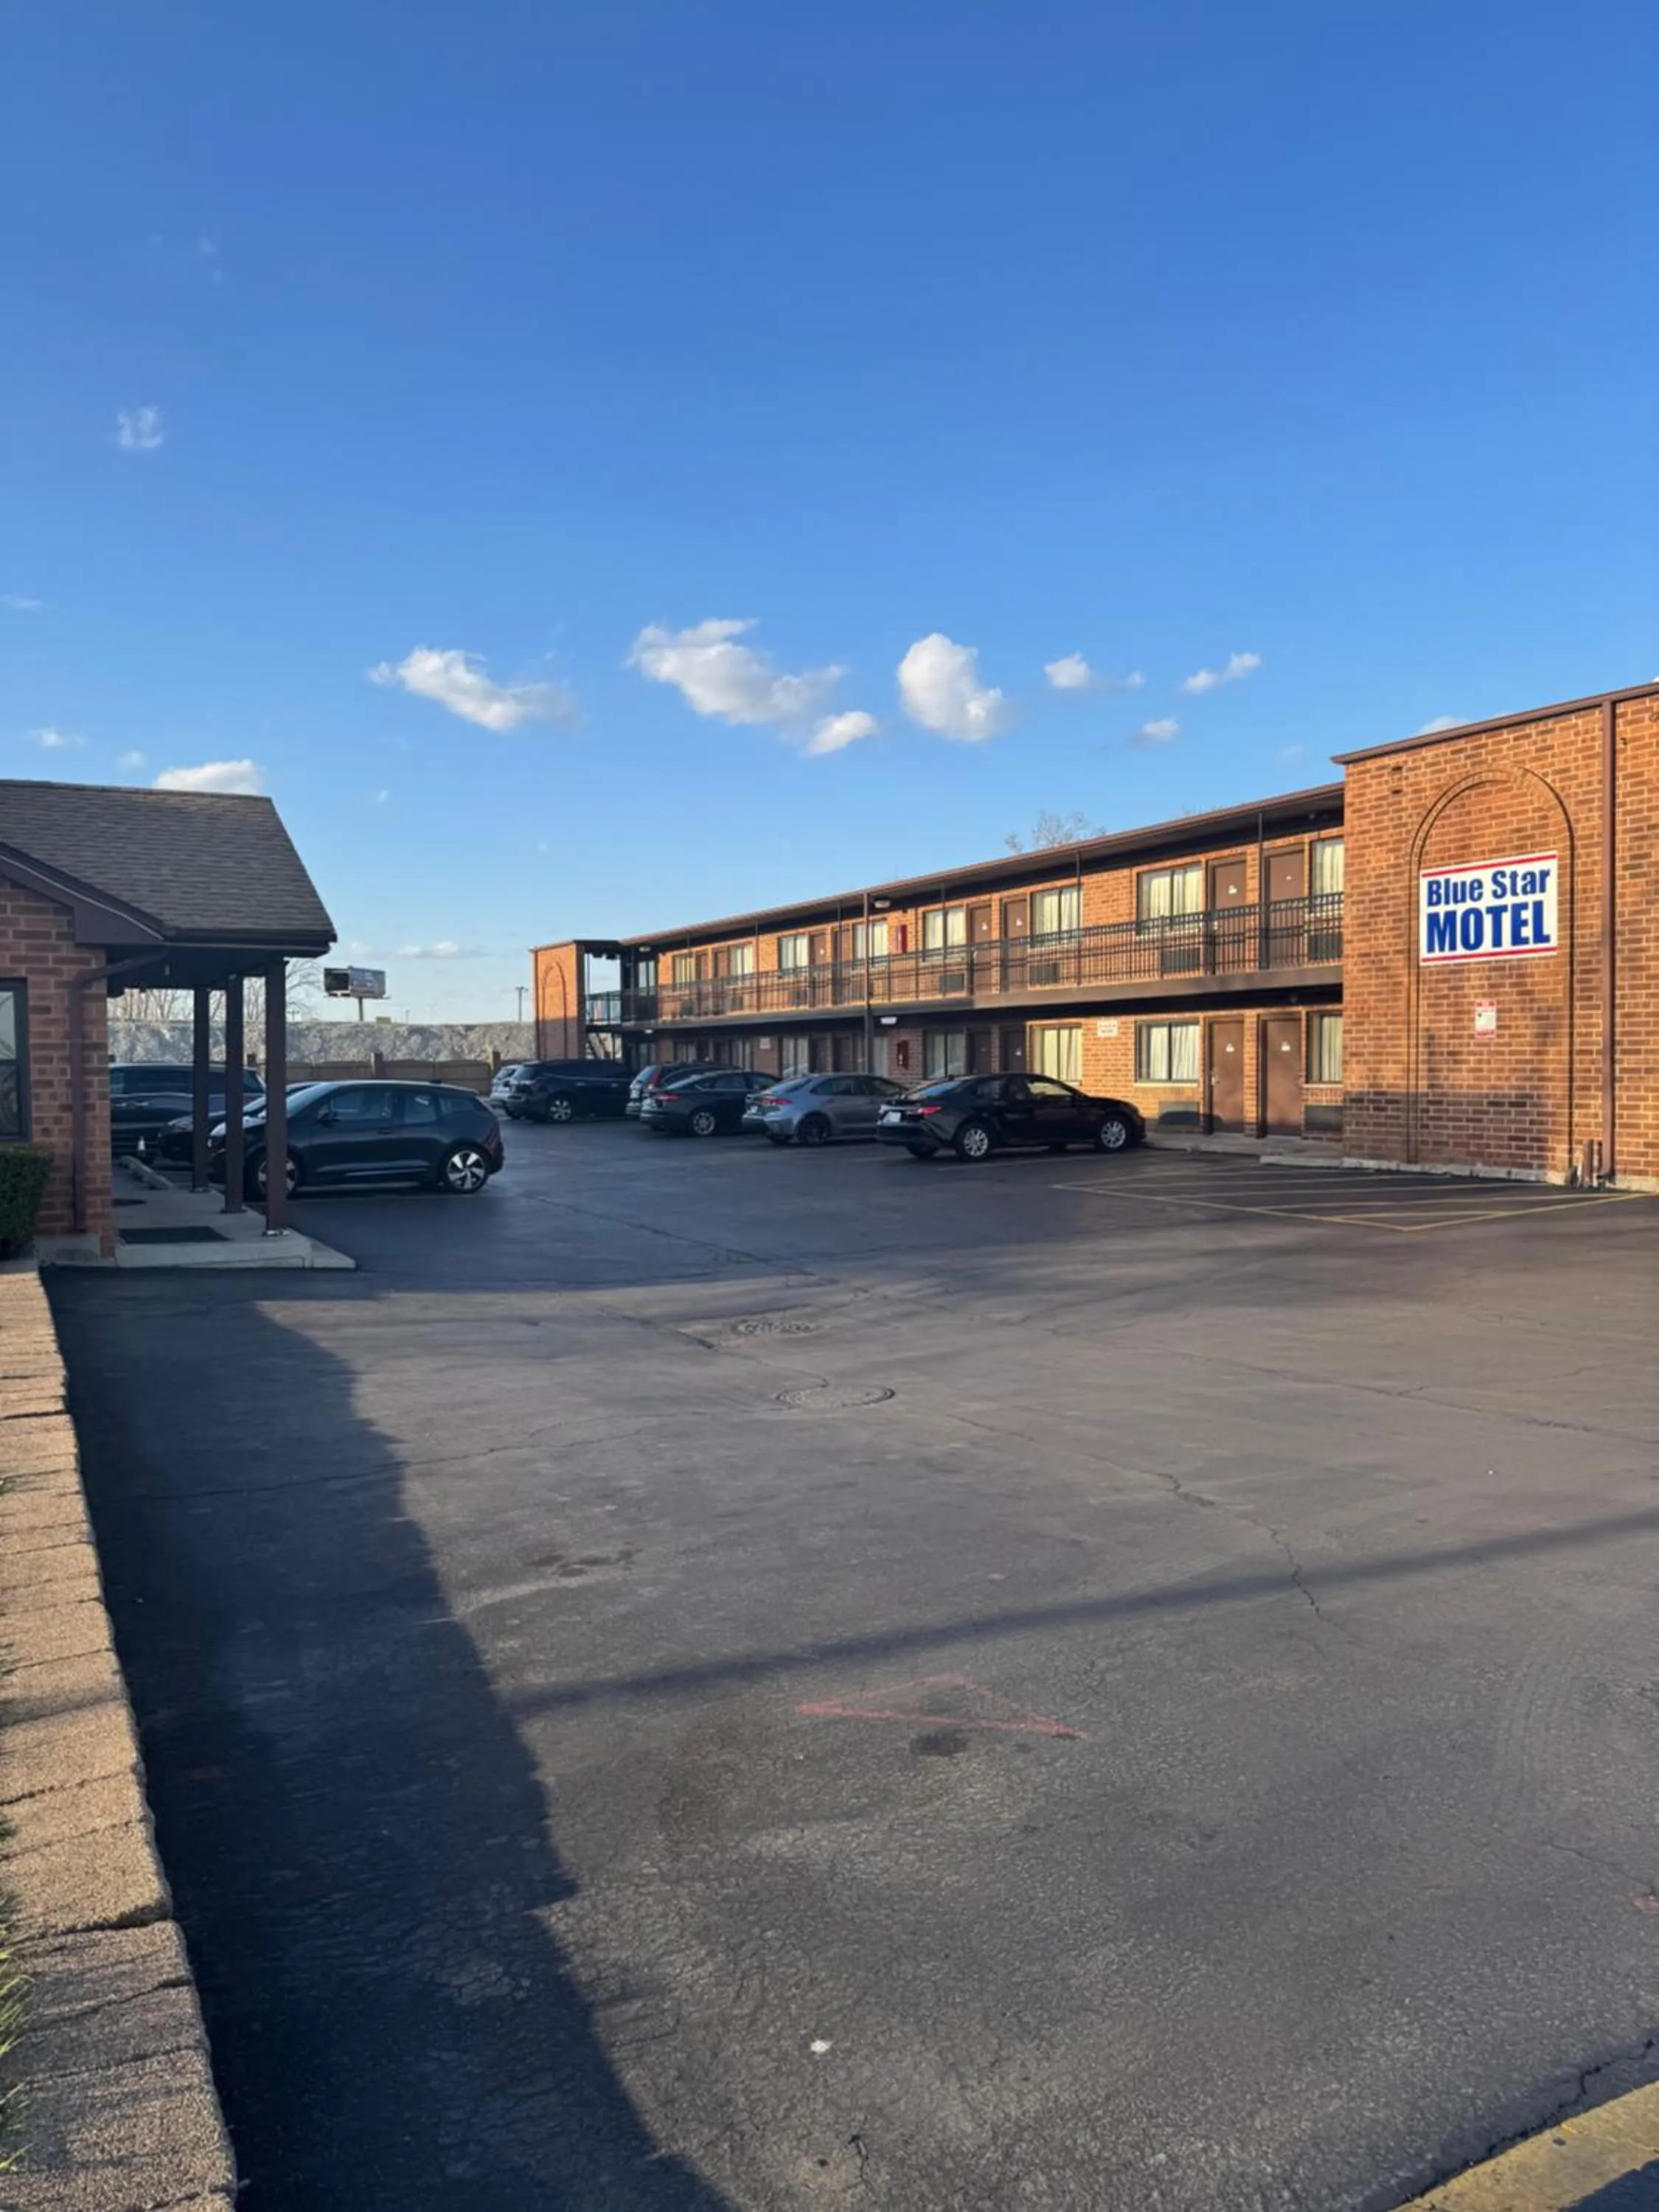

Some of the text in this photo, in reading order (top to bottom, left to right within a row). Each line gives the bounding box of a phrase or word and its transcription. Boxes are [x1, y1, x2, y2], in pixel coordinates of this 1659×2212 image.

[1427, 869, 1551, 907] Blue Star
[1426, 900, 1551, 953] MOTEL
